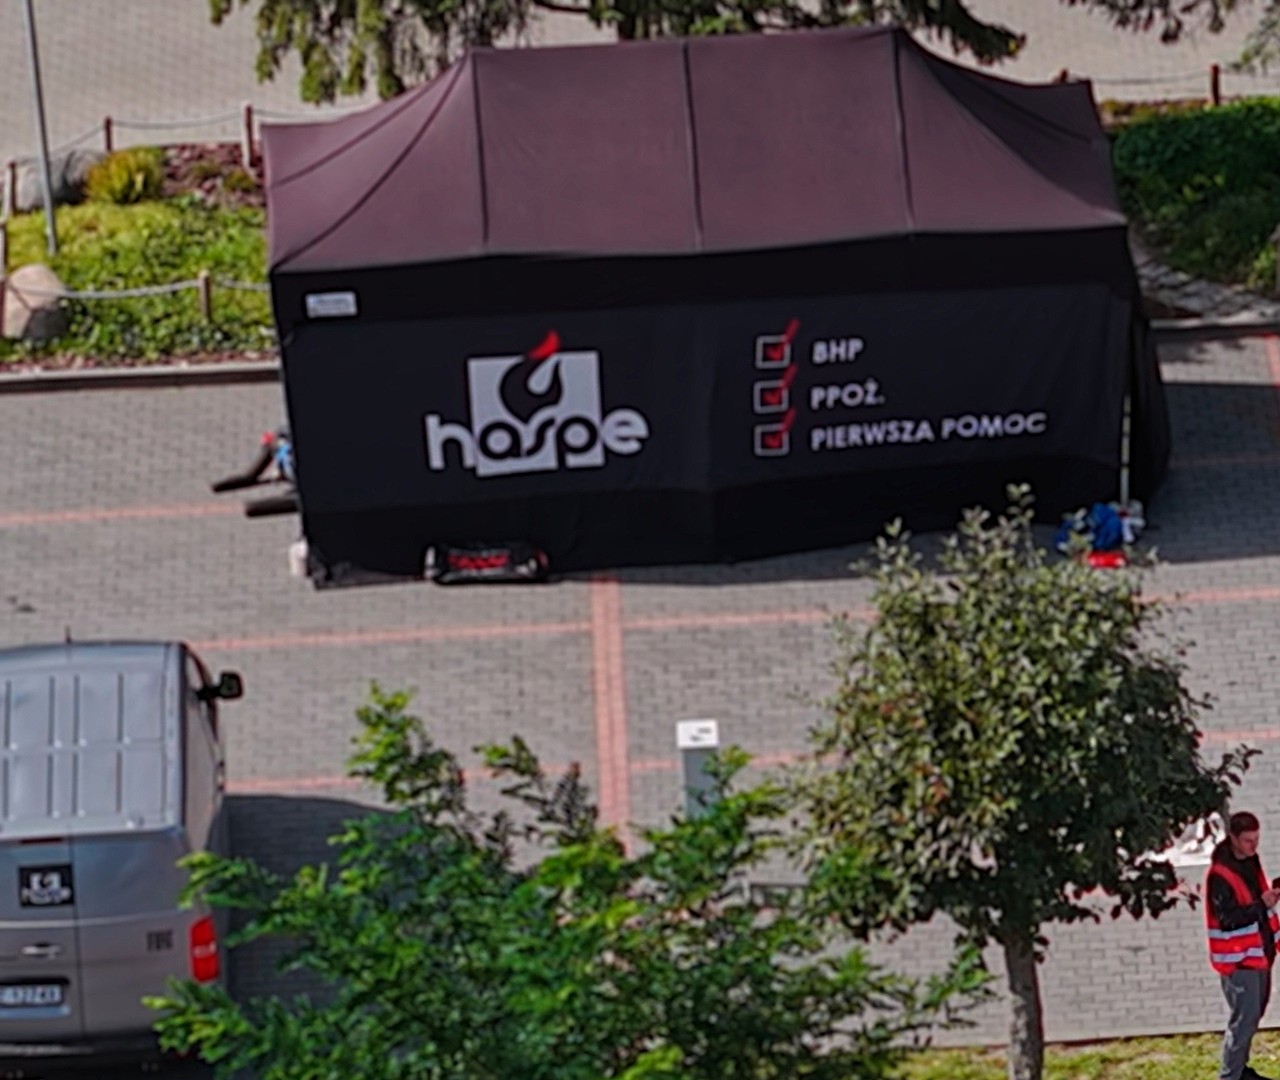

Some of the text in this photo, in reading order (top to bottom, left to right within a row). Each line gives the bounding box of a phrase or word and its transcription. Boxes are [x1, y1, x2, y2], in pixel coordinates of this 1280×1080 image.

[812, 338, 863, 364] BHP
[811, 377, 885, 410] PPOŻ.
[424, 408, 649, 470] haspe
[810, 412, 1047, 451] PIERWSZA POMOC
